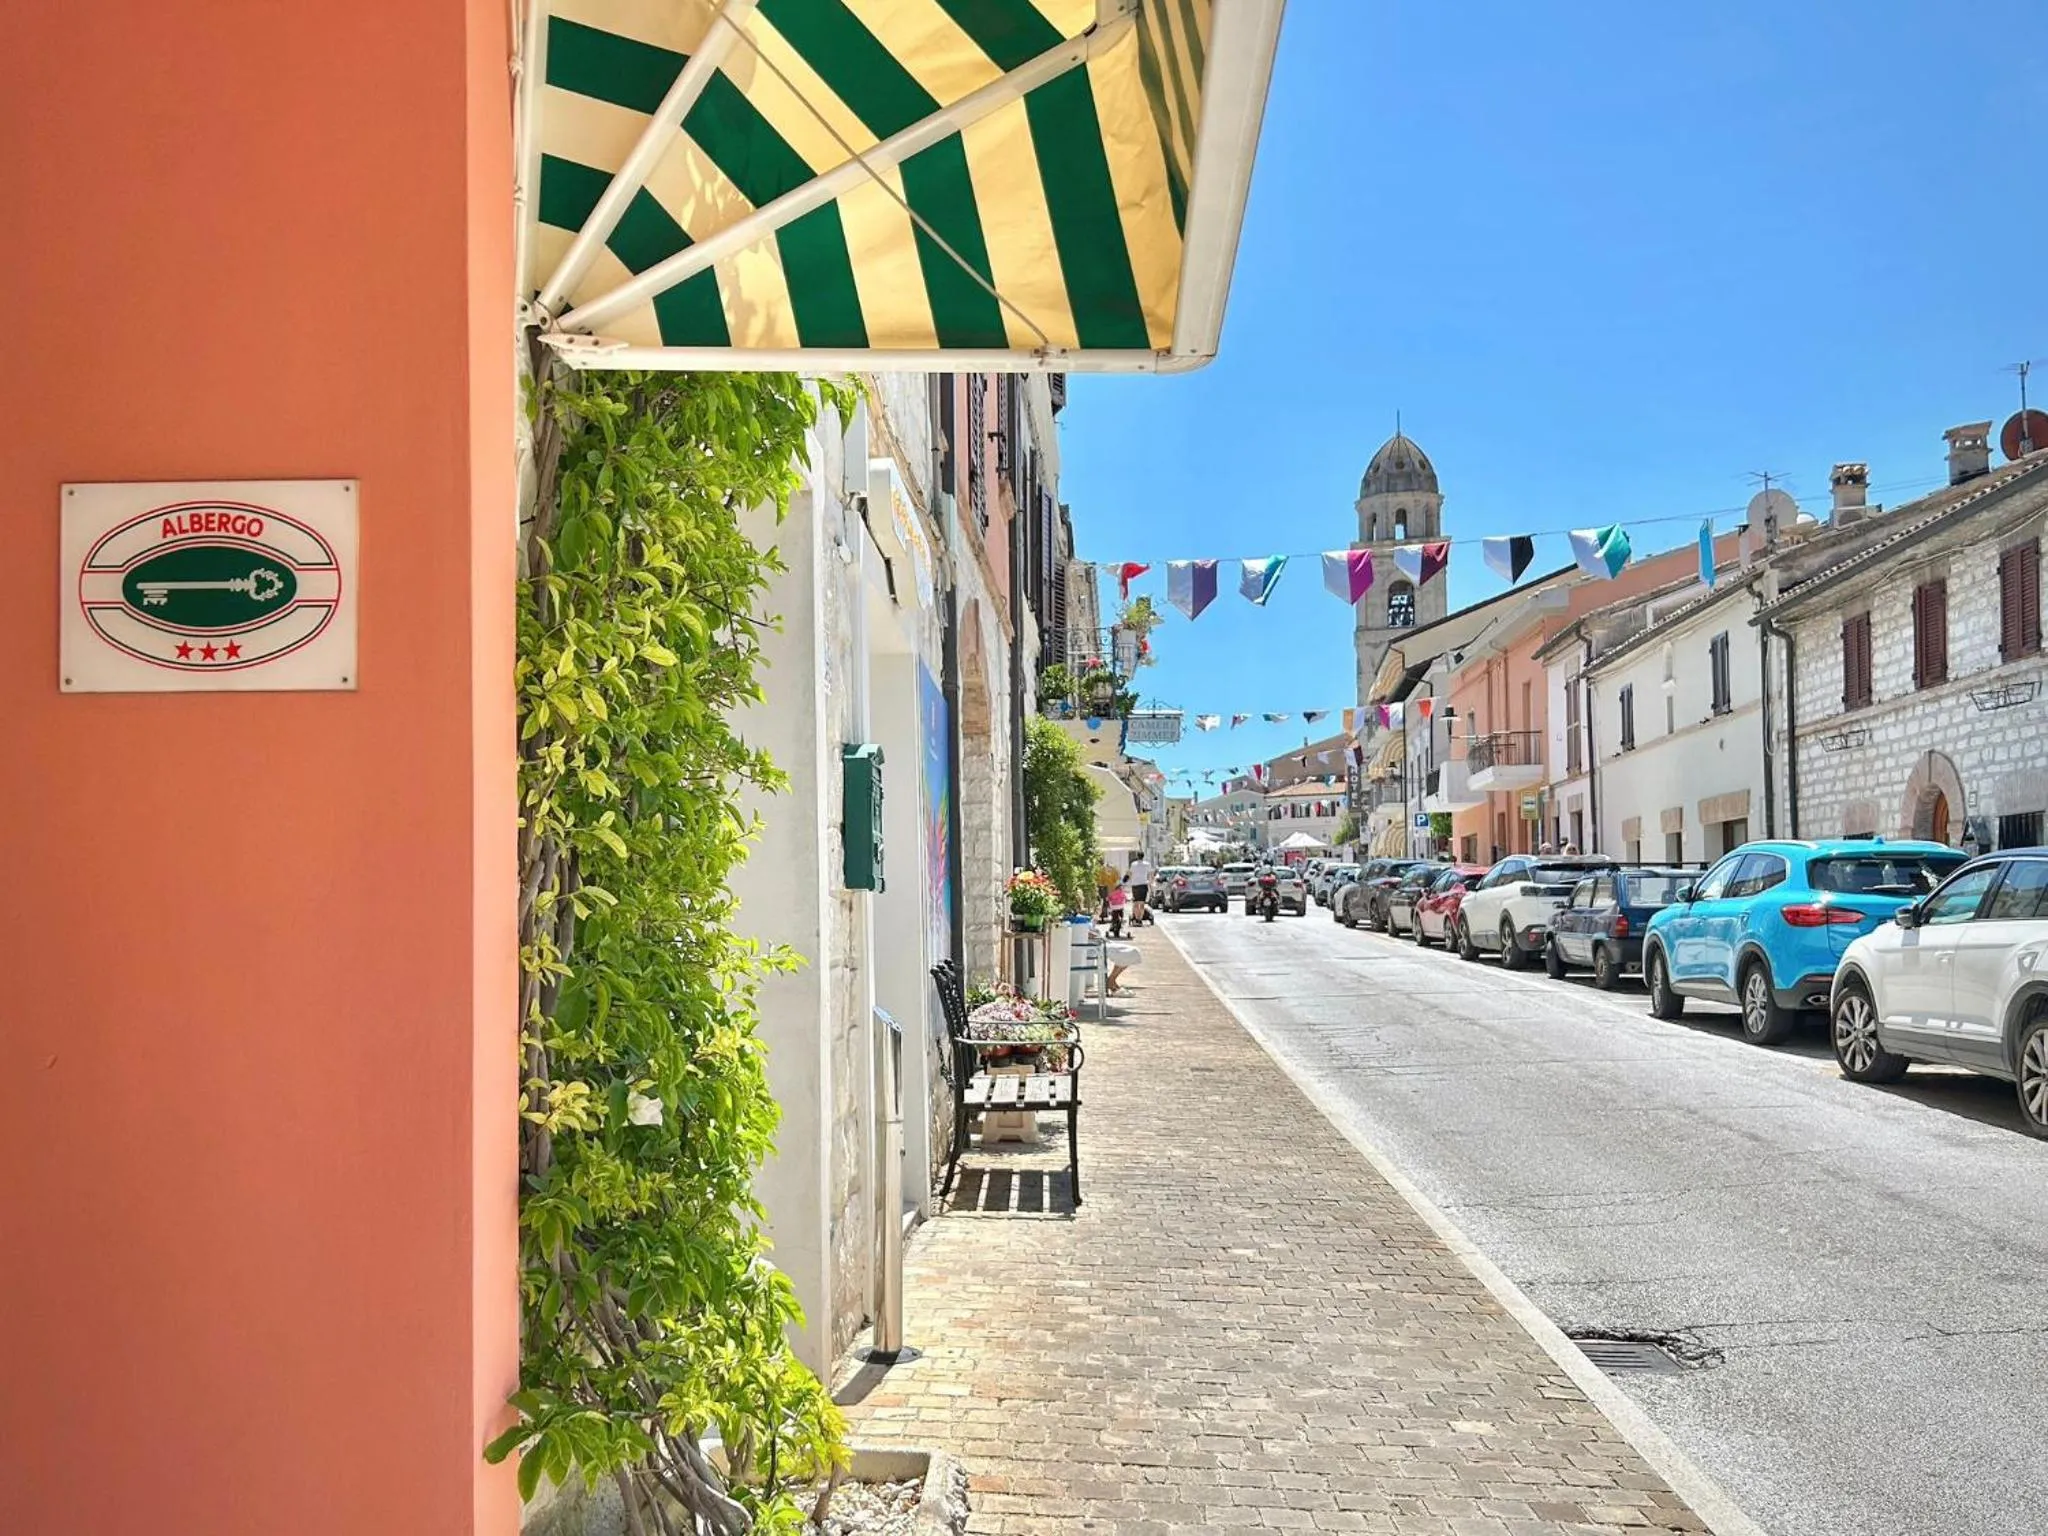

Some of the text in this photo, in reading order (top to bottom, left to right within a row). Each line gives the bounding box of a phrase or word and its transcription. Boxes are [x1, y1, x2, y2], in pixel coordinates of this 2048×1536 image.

[161, 513, 264, 538] ALBERGO
[1350, 767, 1358, 808] HOTEL
[1417, 815, 1426, 825] P
